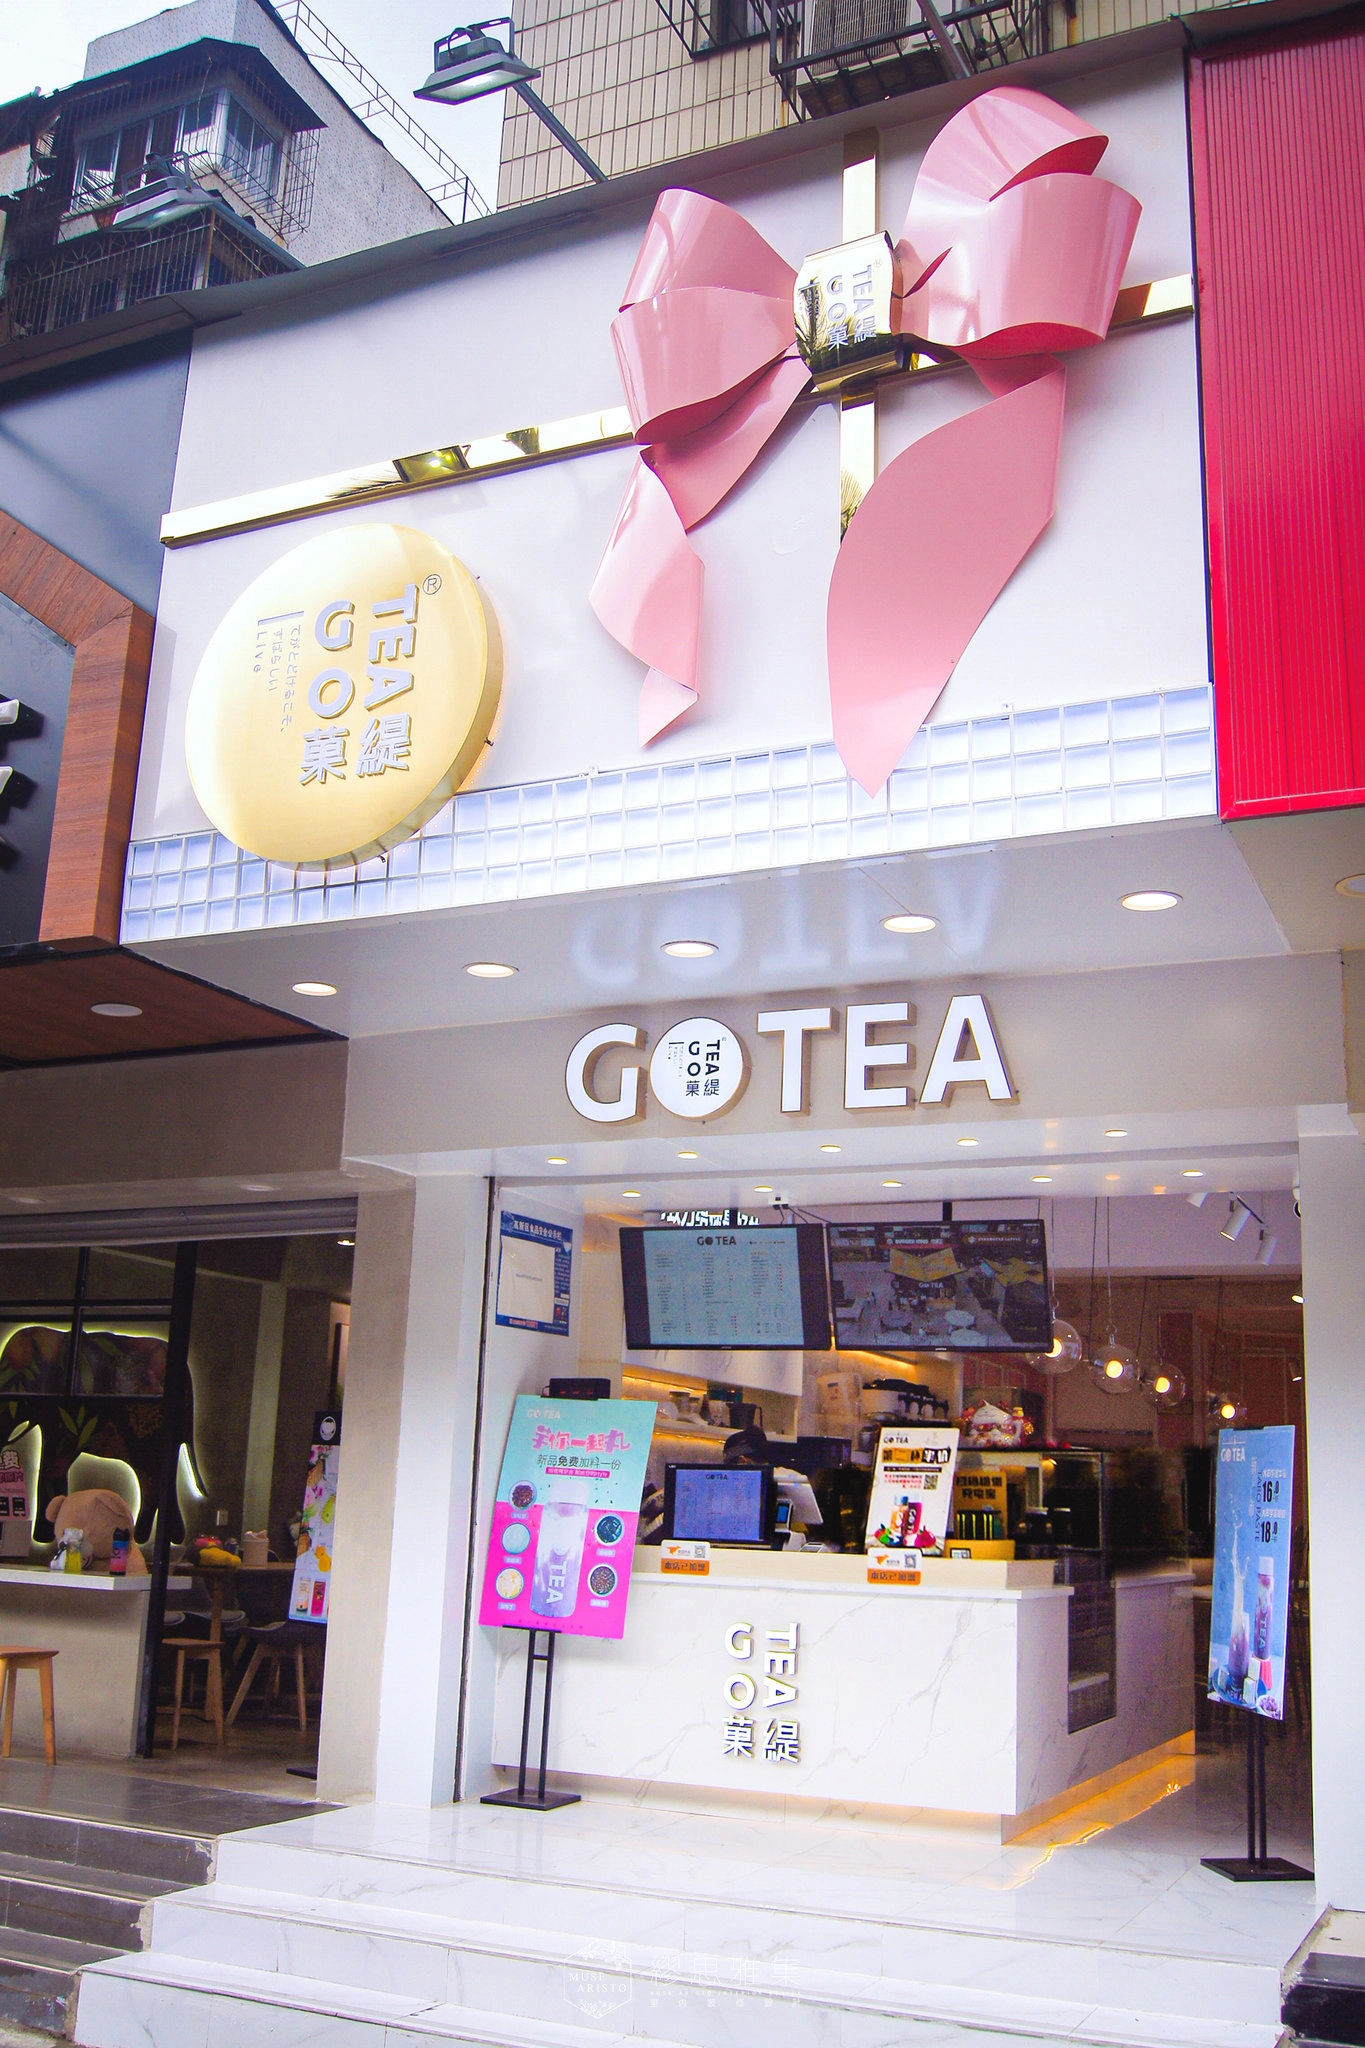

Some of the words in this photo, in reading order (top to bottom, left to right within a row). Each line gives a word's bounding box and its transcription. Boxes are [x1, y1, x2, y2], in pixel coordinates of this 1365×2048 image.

[536, 1454, 622, 1471] 新品免费加料一份
